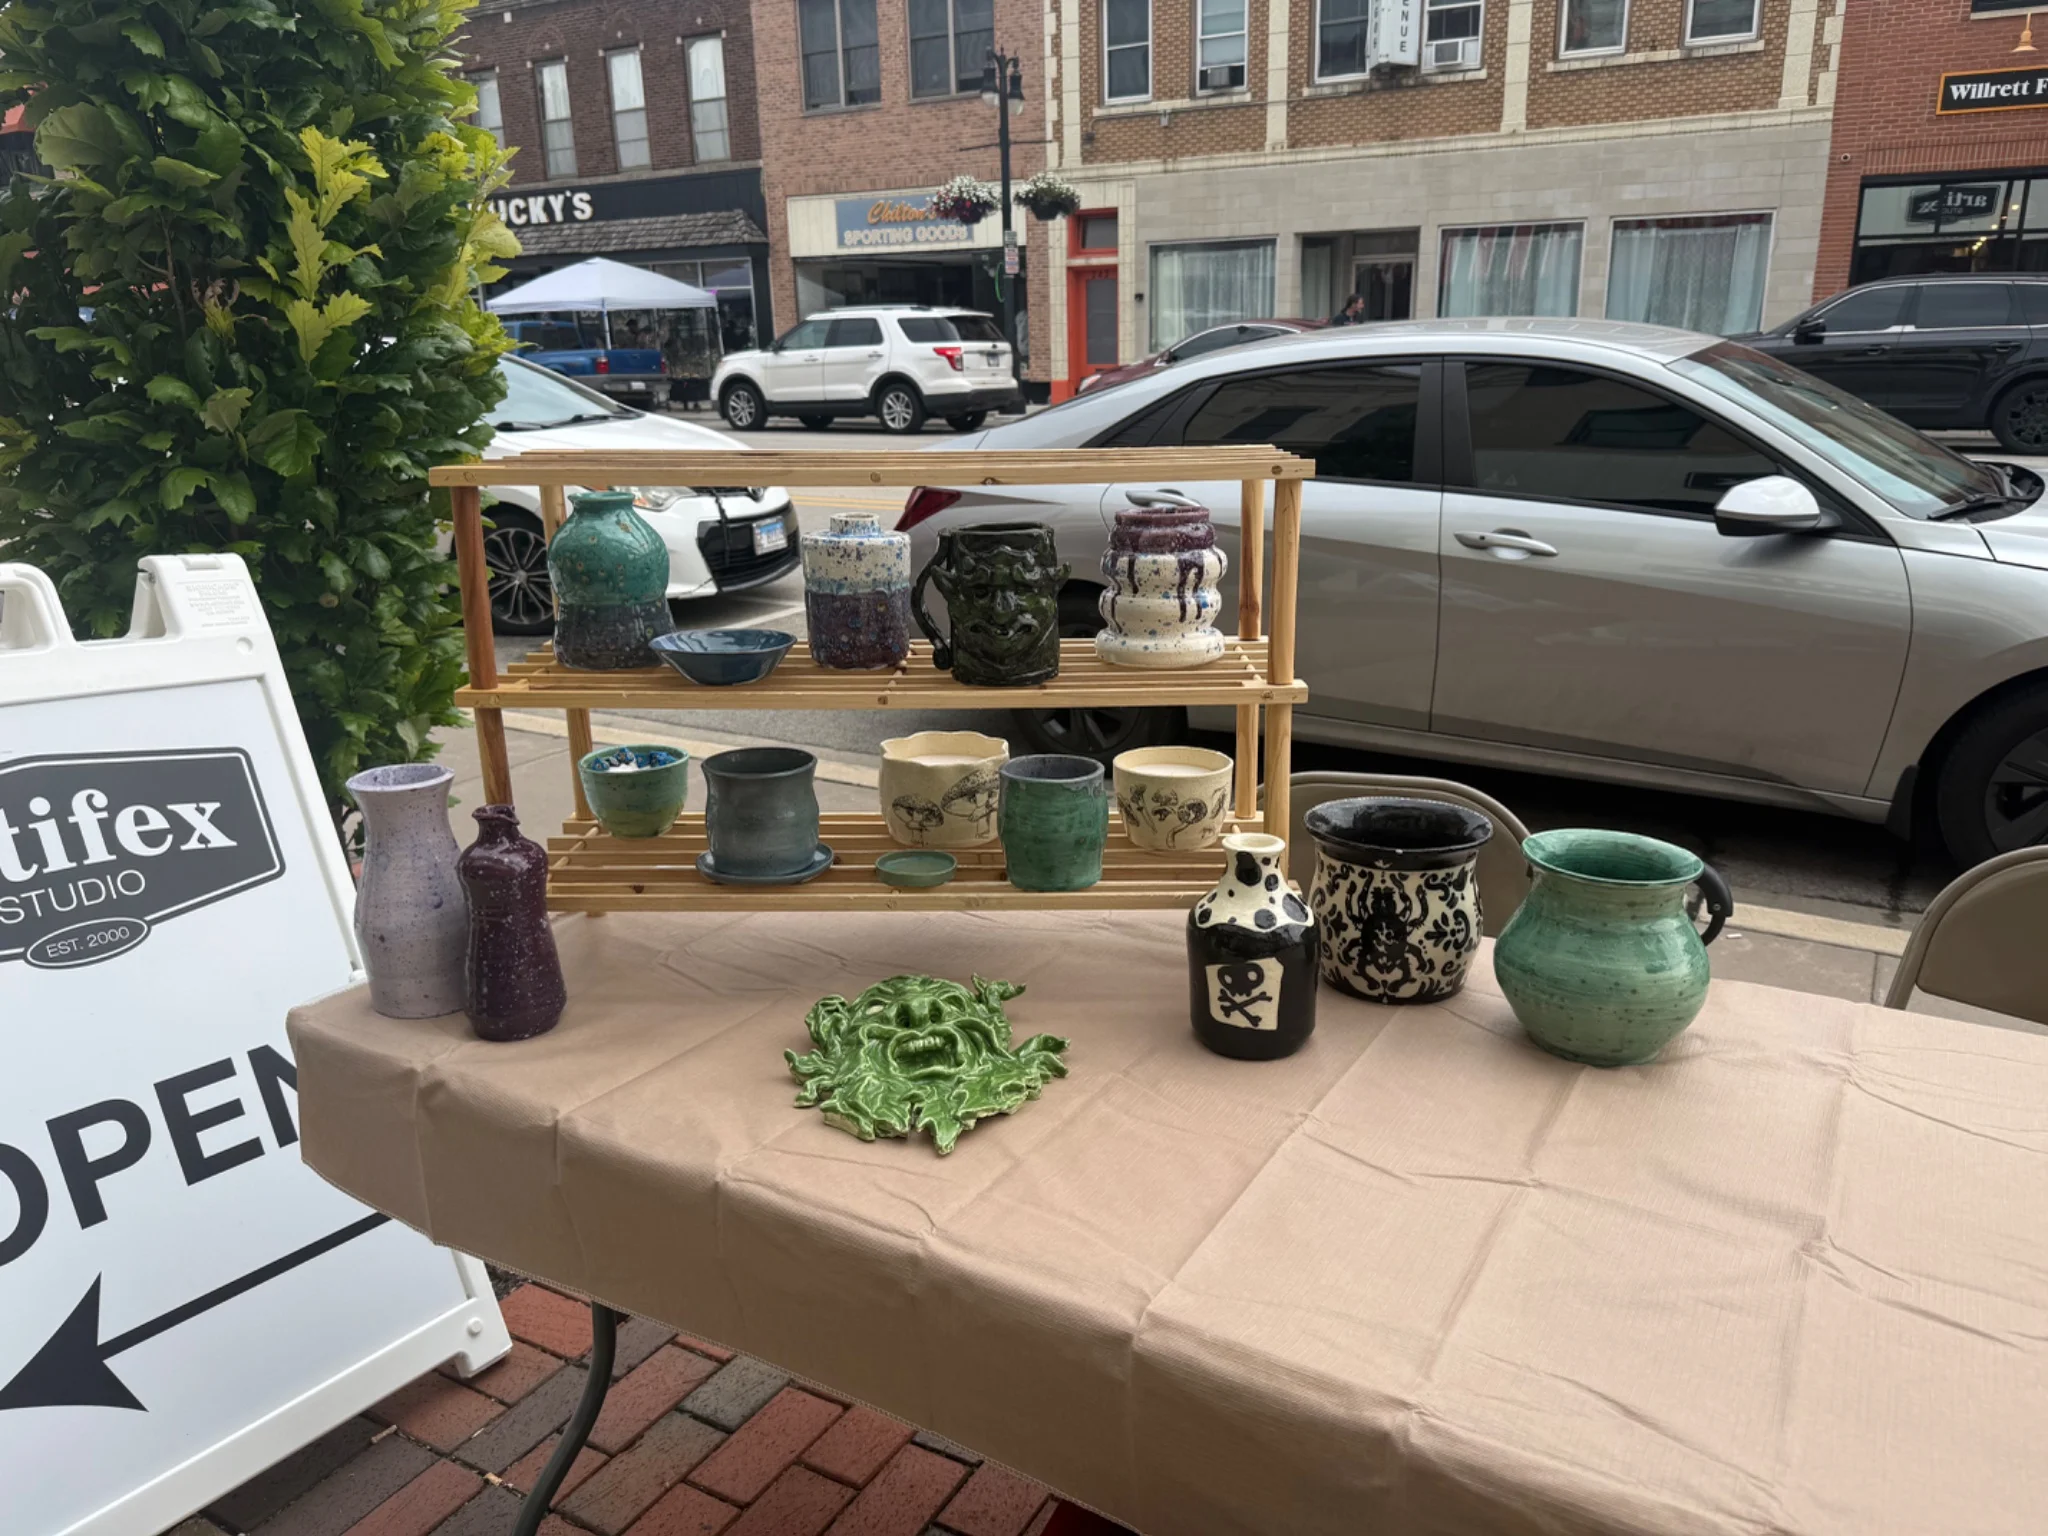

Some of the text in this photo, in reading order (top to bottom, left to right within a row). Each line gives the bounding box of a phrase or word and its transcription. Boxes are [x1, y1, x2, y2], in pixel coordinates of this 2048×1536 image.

[1949, 79, 2031, 101] Willrett
[472, 190, 594, 226] UCKY'S
[844, 224, 968, 246] SPORTING GOODS
[0, 788, 238, 882] tifex
[0, 869, 146, 924] STUDIO
[46, 926, 130, 958] EST. 2000
